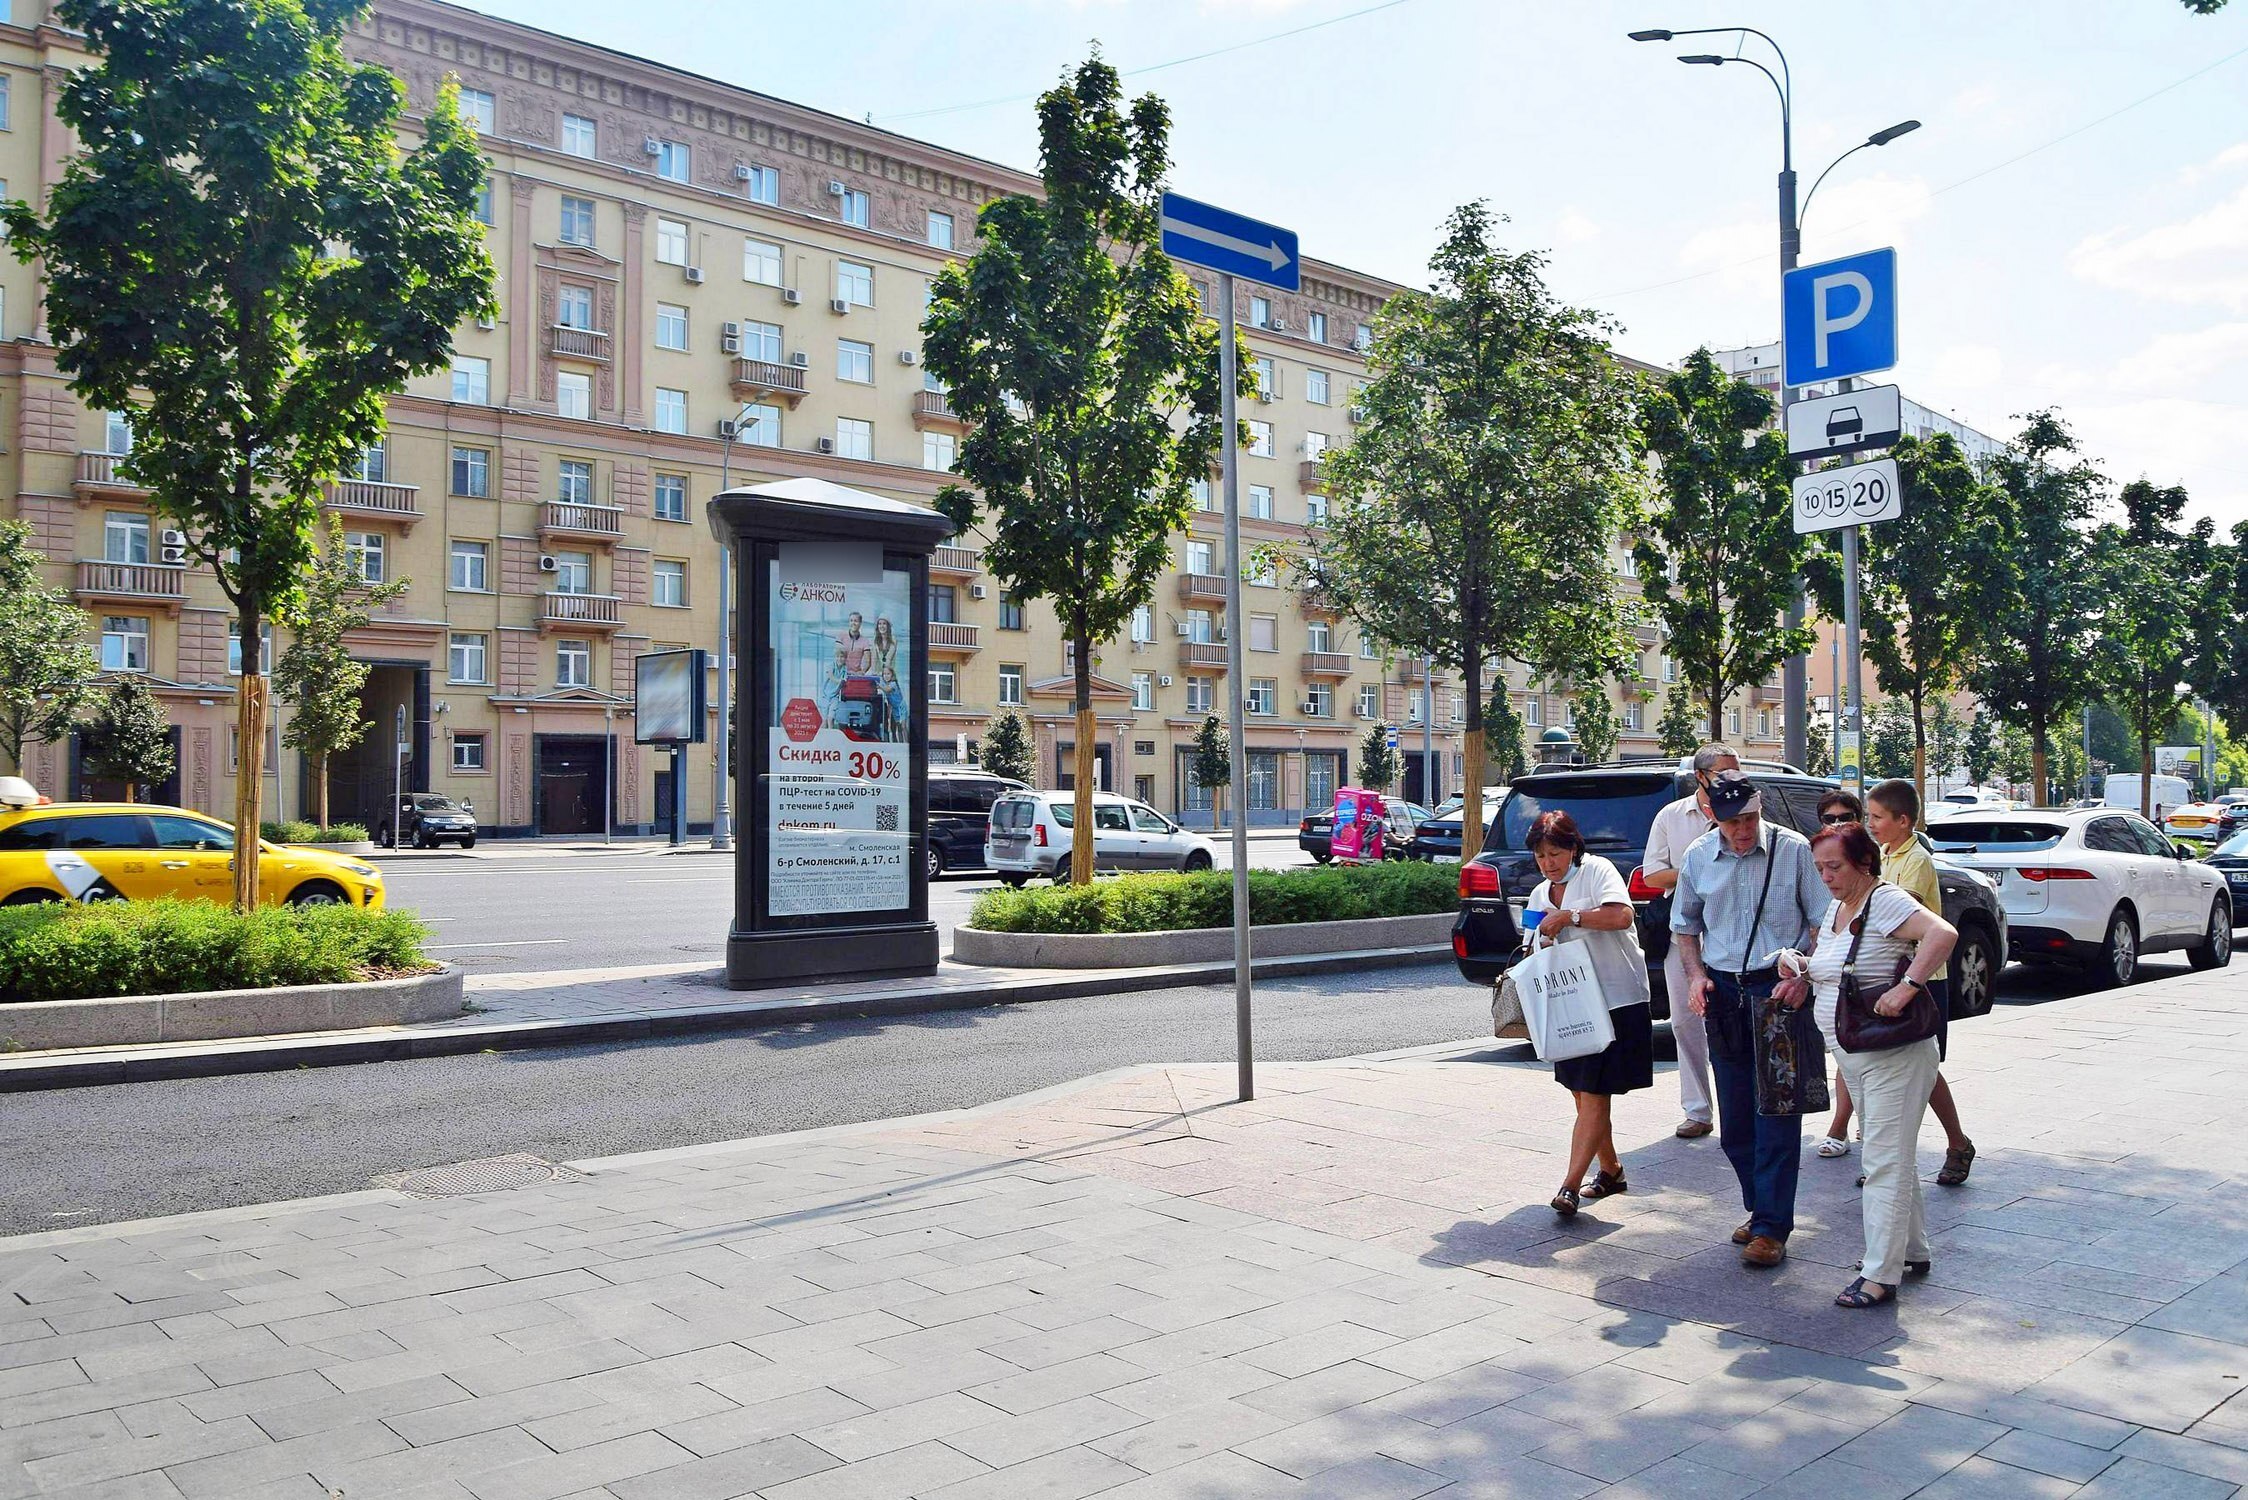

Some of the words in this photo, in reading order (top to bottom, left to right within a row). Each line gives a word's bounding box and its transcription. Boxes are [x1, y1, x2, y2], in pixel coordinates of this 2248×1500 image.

[1813, 271, 1874, 369] P
[1805, 494, 1820, 510] 10
[1826, 487, 1844, 509] 15
[1853, 479, 1884, 508] 20
[800, 588, 846, 604] ДНКОМ
[779, 745, 841, 764] Скидка
[848, 752, 901, 779] 30%
[792, 774, 824, 783] второй
[779, 787, 823, 797] ПЦР-тест
[837, 787, 882, 797] COVID-19
[787, 803, 822, 811] течение
[825, 802, 830, 810] 5
[832, 802, 854, 811] дней
[858, 844, 901, 852] Смоленская
[777, 857, 794, 868] б-р
[796, 855, 859, 867] Смоленский,
[861, 858, 870, 866] д.
[873, 855, 886, 866] 17,
[771, 885, 801, 898] ИМЕЮТСЯ
[867, 881, 904, 895] НЕОБХОДИМО
[858, 894, 904, 909] СПЕЦИАЛИСТОМ
[1533, 966, 1587, 994] BARONI
